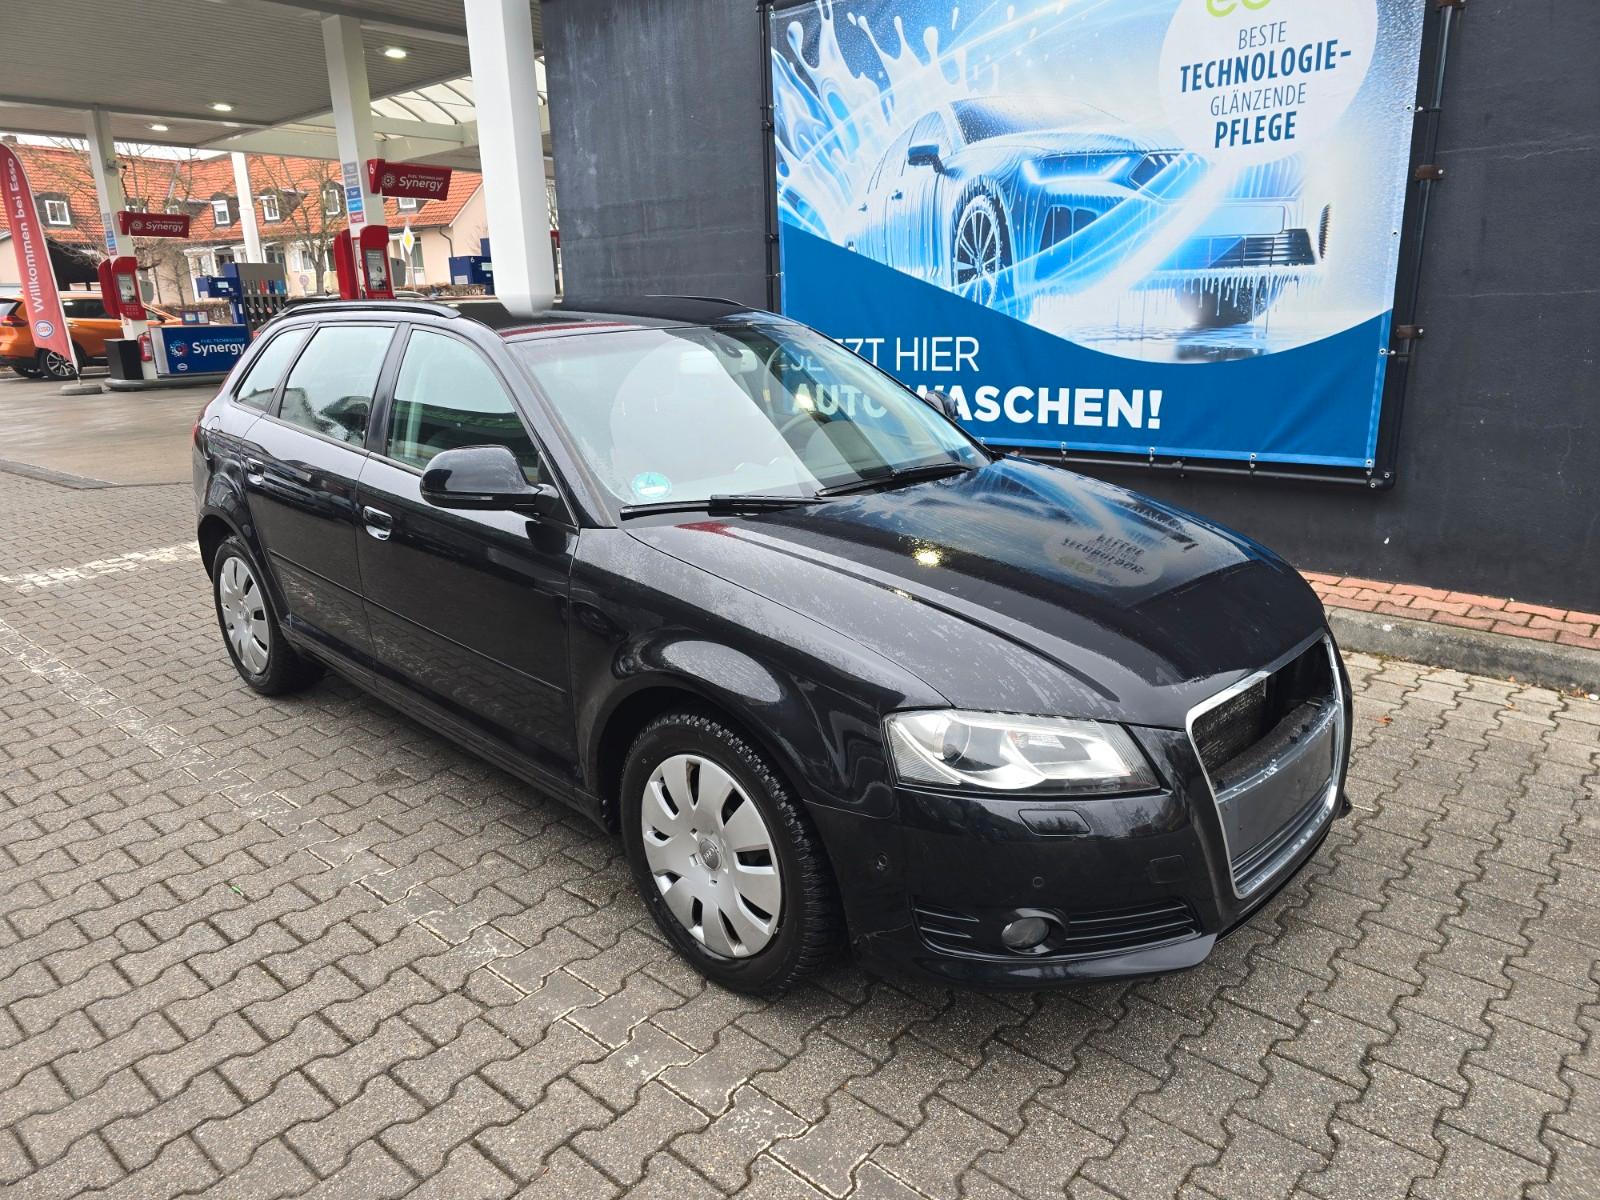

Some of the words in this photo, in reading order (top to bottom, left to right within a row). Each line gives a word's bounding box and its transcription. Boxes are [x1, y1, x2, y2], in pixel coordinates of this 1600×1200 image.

[1238, 21, 1287, 50] BESTE
[1180, 39, 1352, 93] TECHNOLOGIE-
[1210, 82, 1307, 117] GLÄNZENDE
[1214, 111, 1297, 148] PFLEGE
[8, 157, 20, 192] Esso
[399, 176, 443, 192] Synergy
[12, 196, 27, 218] bei
[145, 221, 184, 233] Synergy
[20, 222, 45, 313] Willkommen
[192, 341, 246, 357] Synergy
[896, 336, 980, 372] HIER
